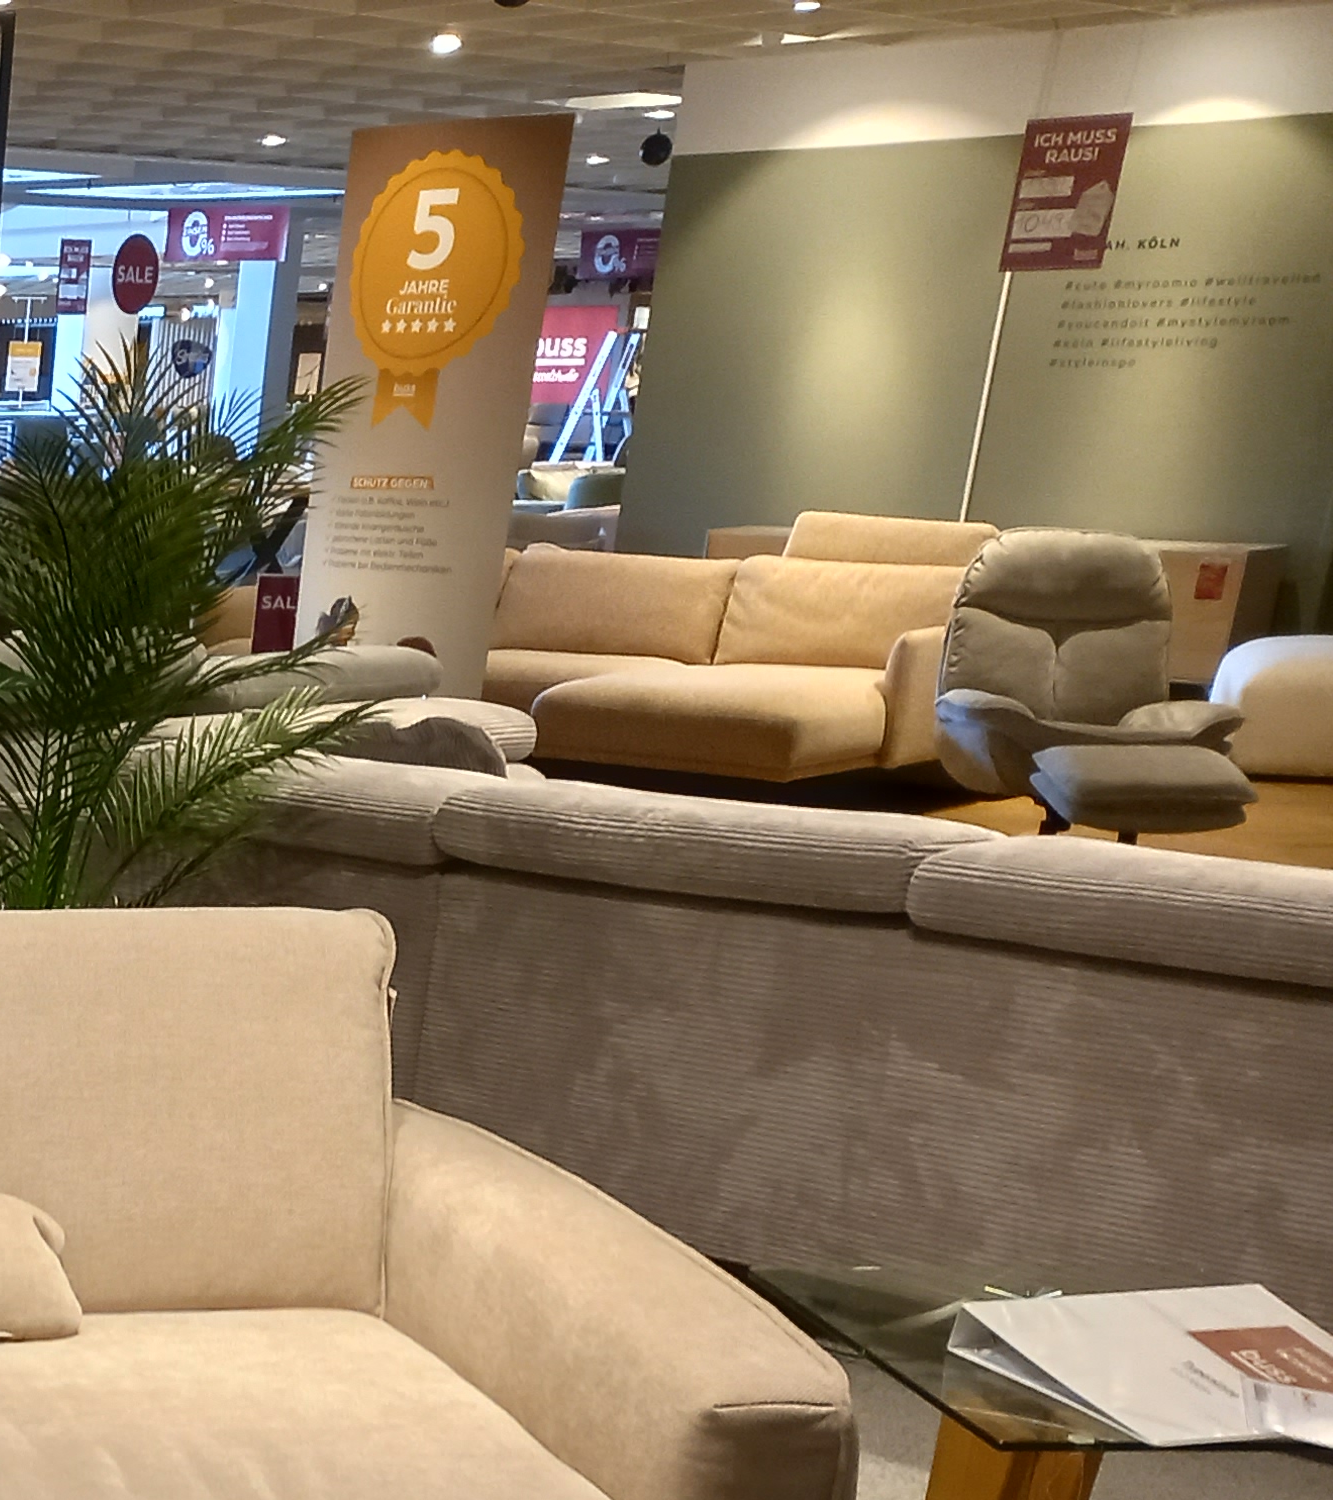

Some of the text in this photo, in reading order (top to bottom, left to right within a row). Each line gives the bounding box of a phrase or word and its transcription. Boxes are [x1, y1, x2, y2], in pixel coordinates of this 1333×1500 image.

[1034, 128, 1118, 148] ICH MUSS
[1045, 147, 1100, 164] RAUS!
[406, 188, 460, 270] 5
[1137, 235, 1180, 250] KÖLN
[117, 265, 154, 284] SALE
[399, 279, 450, 295] JAHRE
[386, 293, 457, 315] Garantie
[353, 477, 428, 489] SCHUTZ GEGEN
